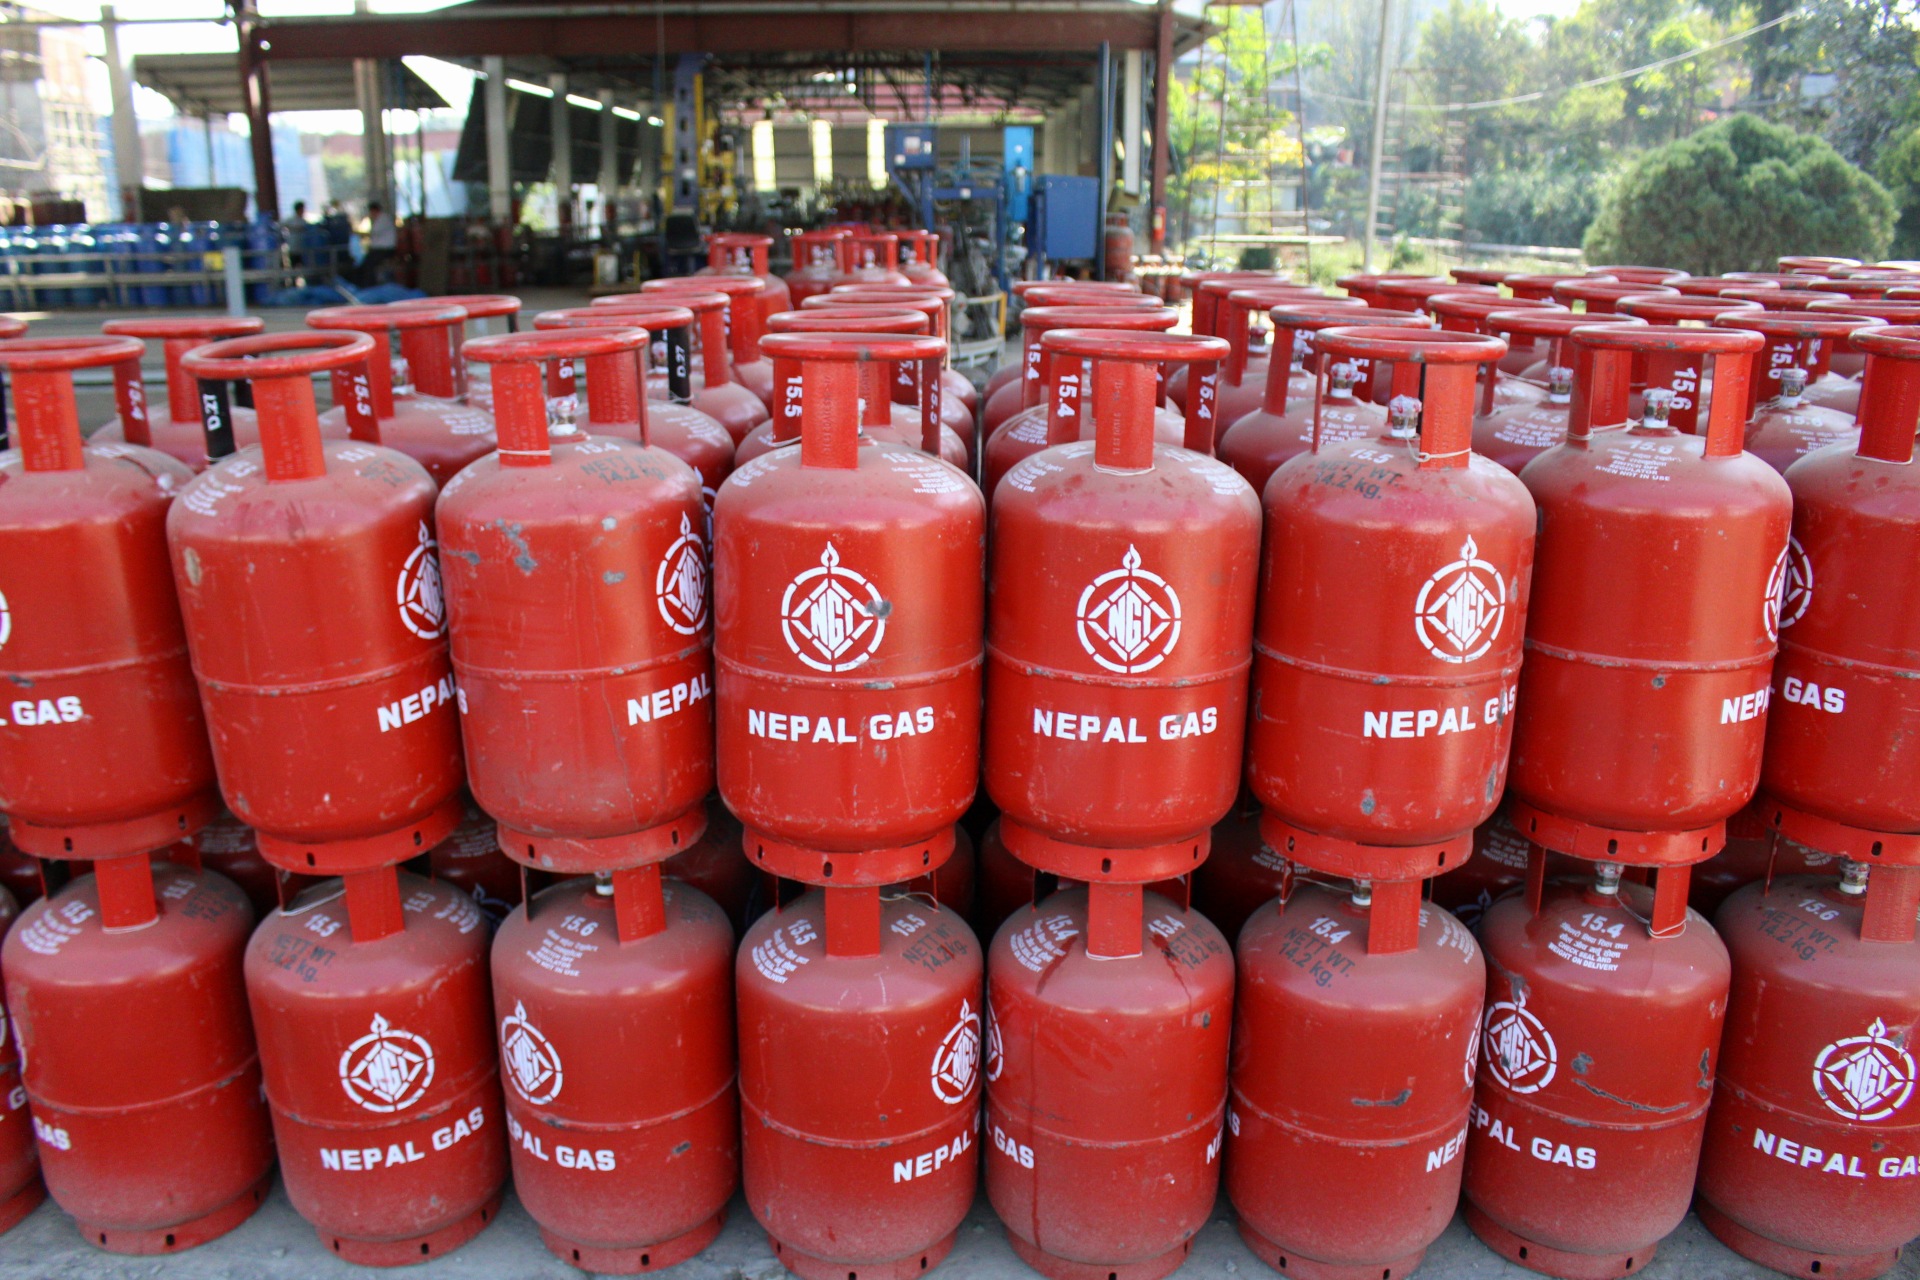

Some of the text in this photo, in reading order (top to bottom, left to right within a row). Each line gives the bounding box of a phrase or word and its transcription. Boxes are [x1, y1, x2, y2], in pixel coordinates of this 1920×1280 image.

[675, 345, 687, 379] D.27
[1027, 343, 1041, 380] 15.4
[353, 375, 372, 416] 15.5
[784, 375, 803, 418] 15.5
[1057, 374, 1079, 417] 15.4
[1670, 367, 1697, 410] 15.6
[1349, 448, 1395, 464] 15.5
[1629, 440, 1675, 454] 15.6
[1314, 471, 1381, 499] 14.2 kg.
[1609, 464, 1658, 475] REGULATOR
[809, 588, 853, 651] NGI
[1108, 589, 1151, 652] NGI
[1447, 580, 1485, 643] NGI
[12, 695, 83, 726] GAS
[377, 672, 457, 733] NEPAL
[627, 672, 711, 726] NEPAL
[1783, 676, 1845, 714] GAS
[748, 706, 935, 744] NEPAL GAS
[1033, 706, 1218, 743] NEPAL GAS
[1363, 706, 1476, 739] NEPAL
[304, 913, 341, 938] 15.5
[560, 914, 600, 937] 15.6
[890, 913, 926, 937] 15.5
[1046, 914, 1079, 941] 15.4
[1148, 914, 1186, 938] 15.4
[1581, 912, 1625, 939] 15.4
[1798, 899, 1839, 920] 15.6
[788, 919, 817, 946] 15.5
[1309, 917, 1352, 945] 15.4
[1758, 920, 1816, 961] 14.2 kg.
[1808, 928, 1838, 953] WT.
[1279, 942, 1333, 988] 14.2 kg.
[1284, 927, 1356, 978] NETT WT.
[1548, 941, 1572, 960] WEIGHT
[1572, 956, 1582, 965] ON
[1583, 959, 1618, 971] DELIVERY
[1558, 941, 1579, 956] CHECK
[1579, 950, 1595, 961] SEAL
[1596, 956, 1612, 964] AND
[367, 1049, 409, 1096] NGI
[1844, 1052, 1888, 1104] NGI
[320, 1106, 484, 1171] NEPAL GAS
[994, 1125, 1034, 1169] GAS
[1469, 1102, 1597, 1170] EPAL GAS
[1753, 1127, 1866, 1178] NEPAL
[555, 1145, 616, 1171] GAS
[893, 1129, 972, 1184] NEPAL
